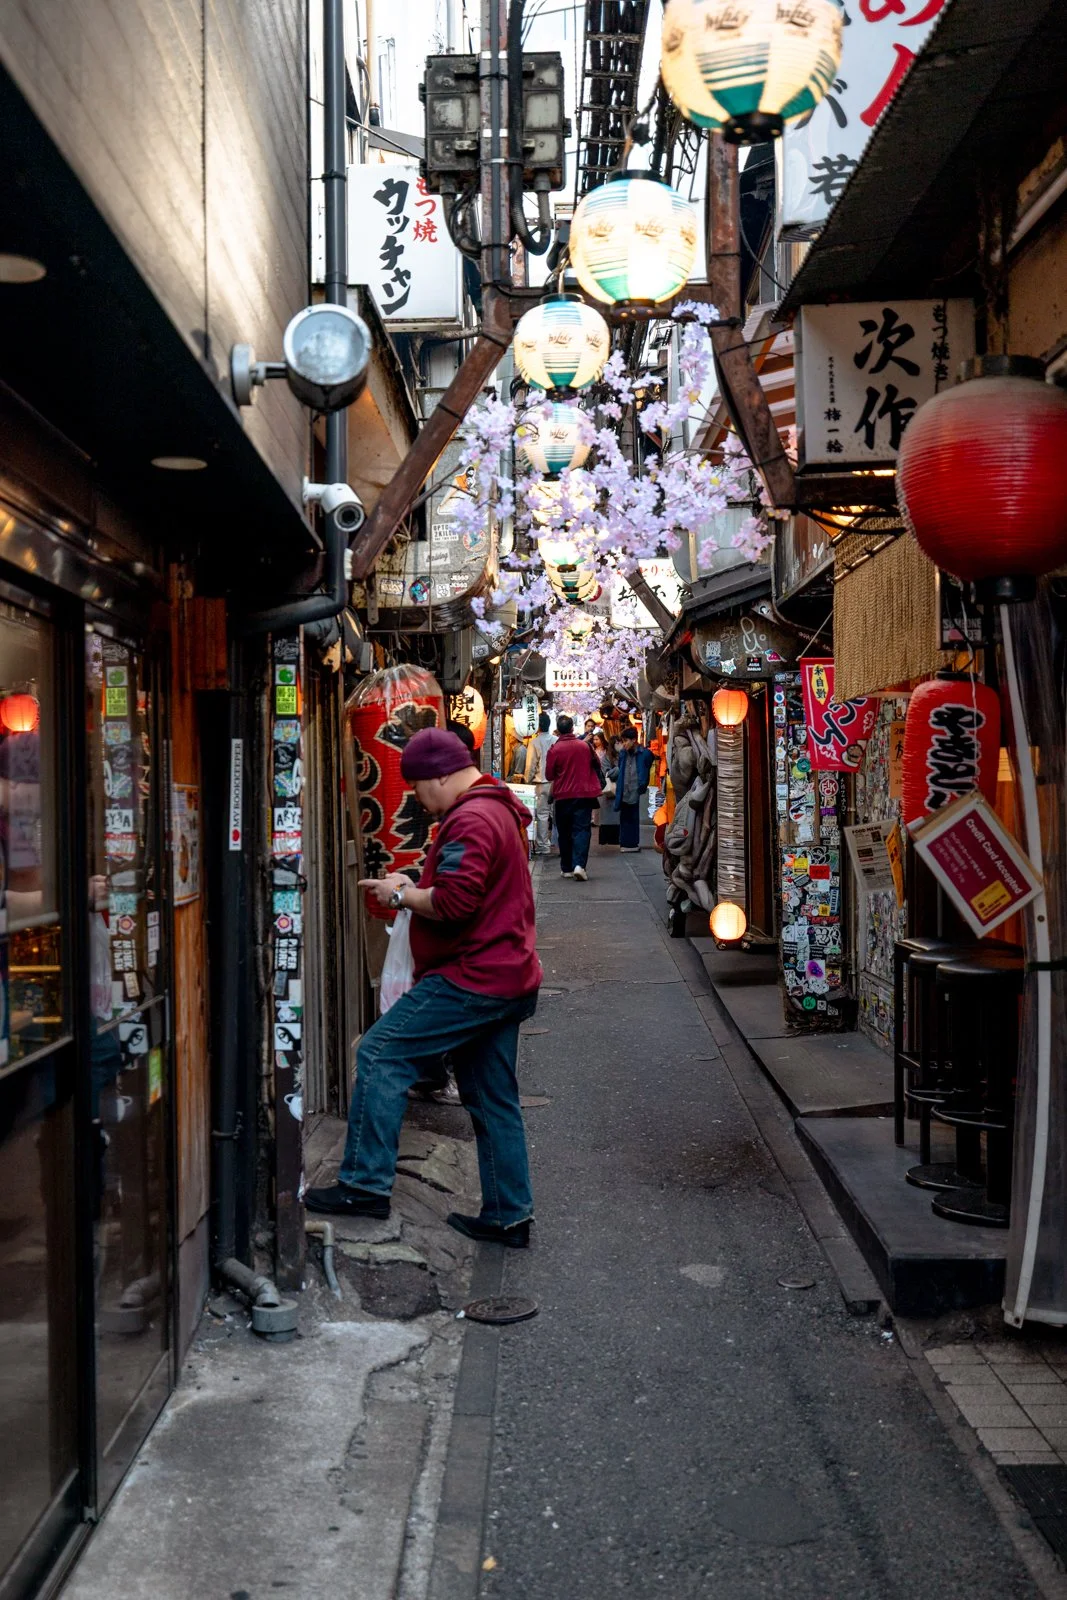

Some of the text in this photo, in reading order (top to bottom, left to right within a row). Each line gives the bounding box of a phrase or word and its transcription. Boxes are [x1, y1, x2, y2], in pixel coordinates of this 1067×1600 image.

[413, 176, 438, 243] もつ焼
[373, 178, 412, 315] ウッチャン
[854, 307, 921, 451] 次作
[233, 743, 241, 809] BOOKKEEPER
[233, 809, 240, 828] MY
[851, 824, 882, 835] FOOD MENU
[966, 818, 1022, 895] Credit Card Accepted
[288, 938, 298, 970] PAPER
